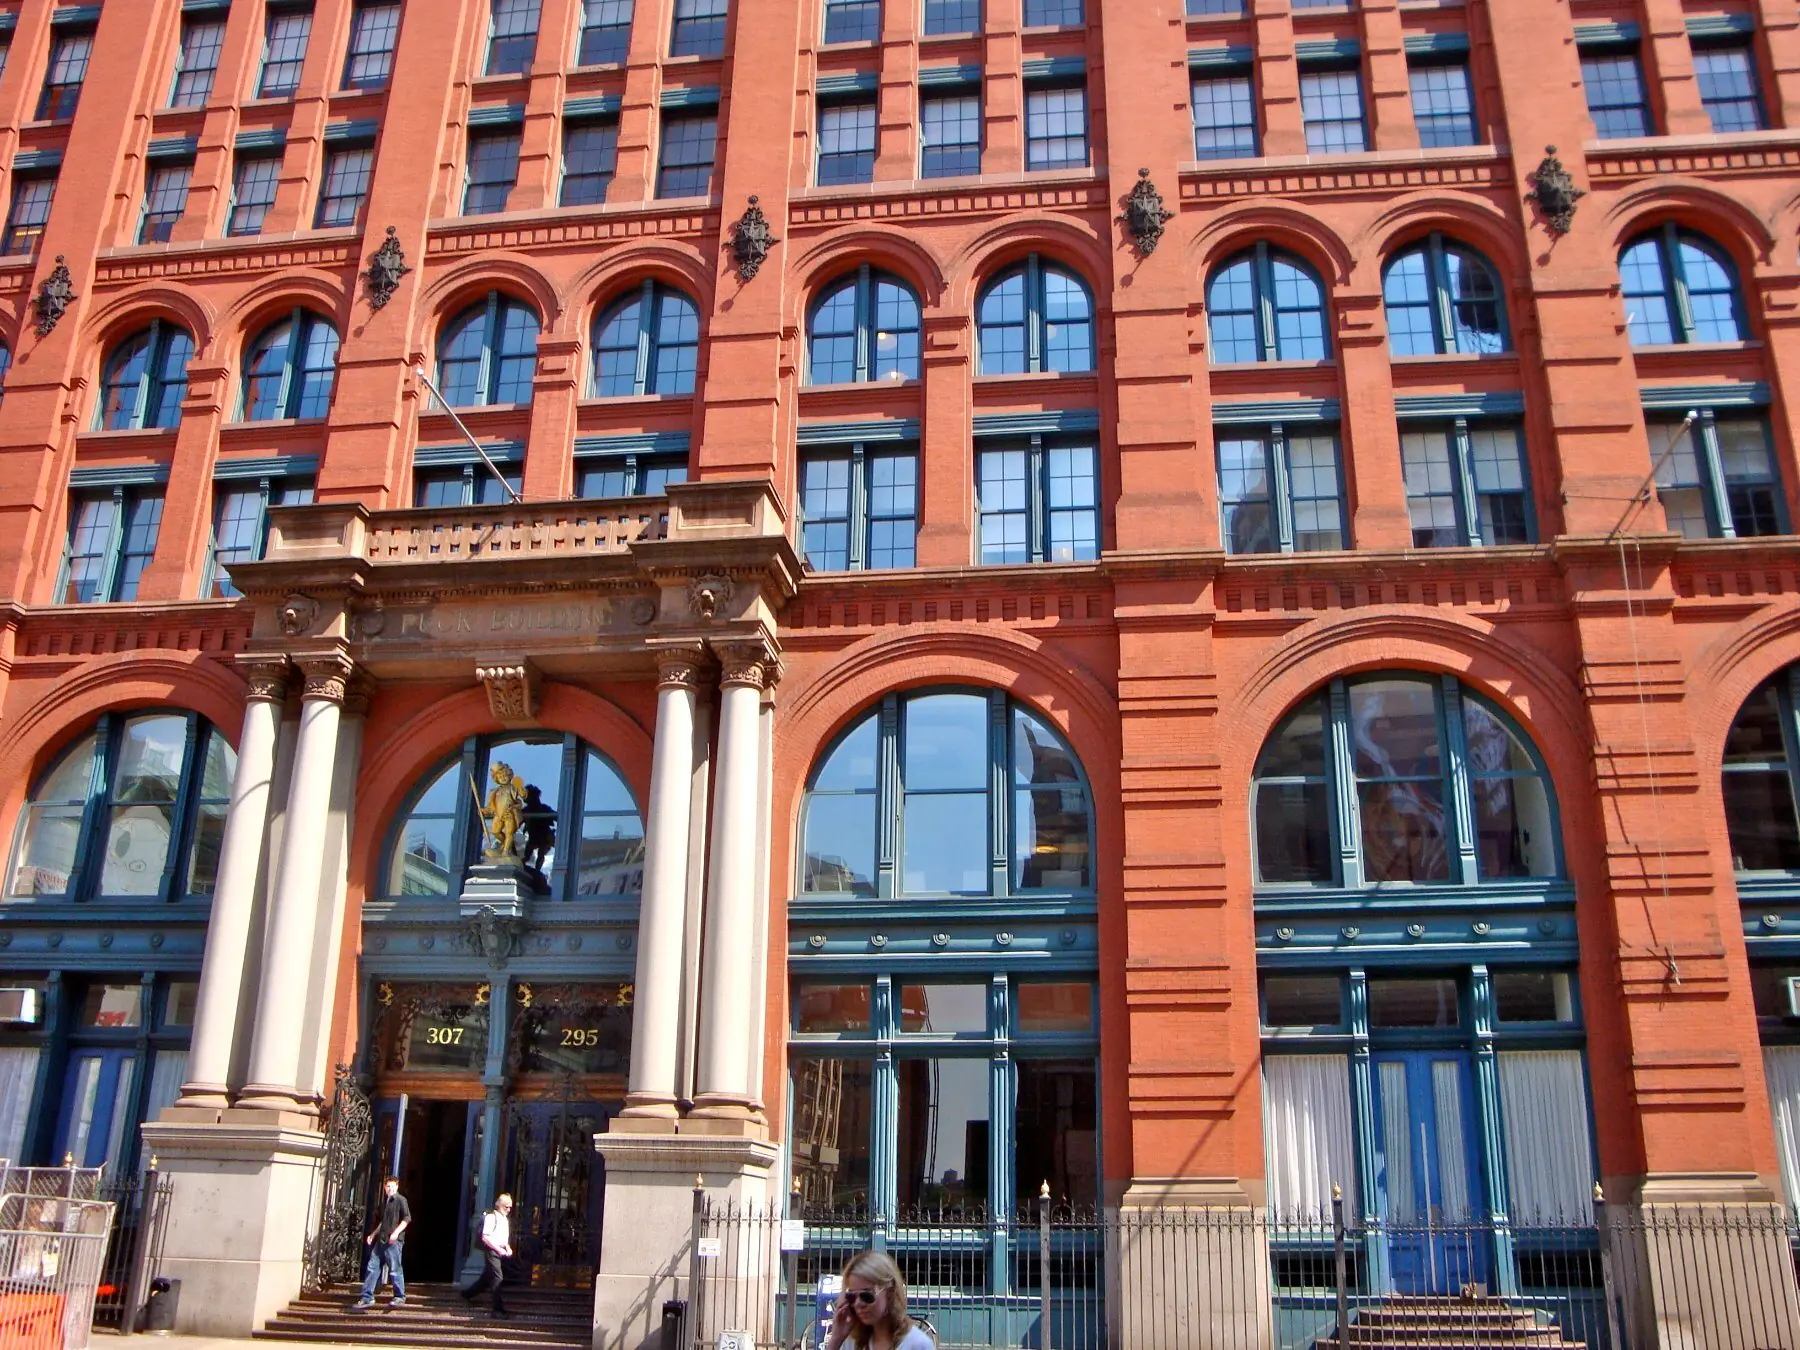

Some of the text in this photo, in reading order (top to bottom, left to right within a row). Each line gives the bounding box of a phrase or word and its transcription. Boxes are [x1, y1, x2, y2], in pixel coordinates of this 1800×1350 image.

[399, 610, 472, 634] PUCK
[426, 1027, 464, 1045] 307
[560, 1029, 599, 1046] 295
